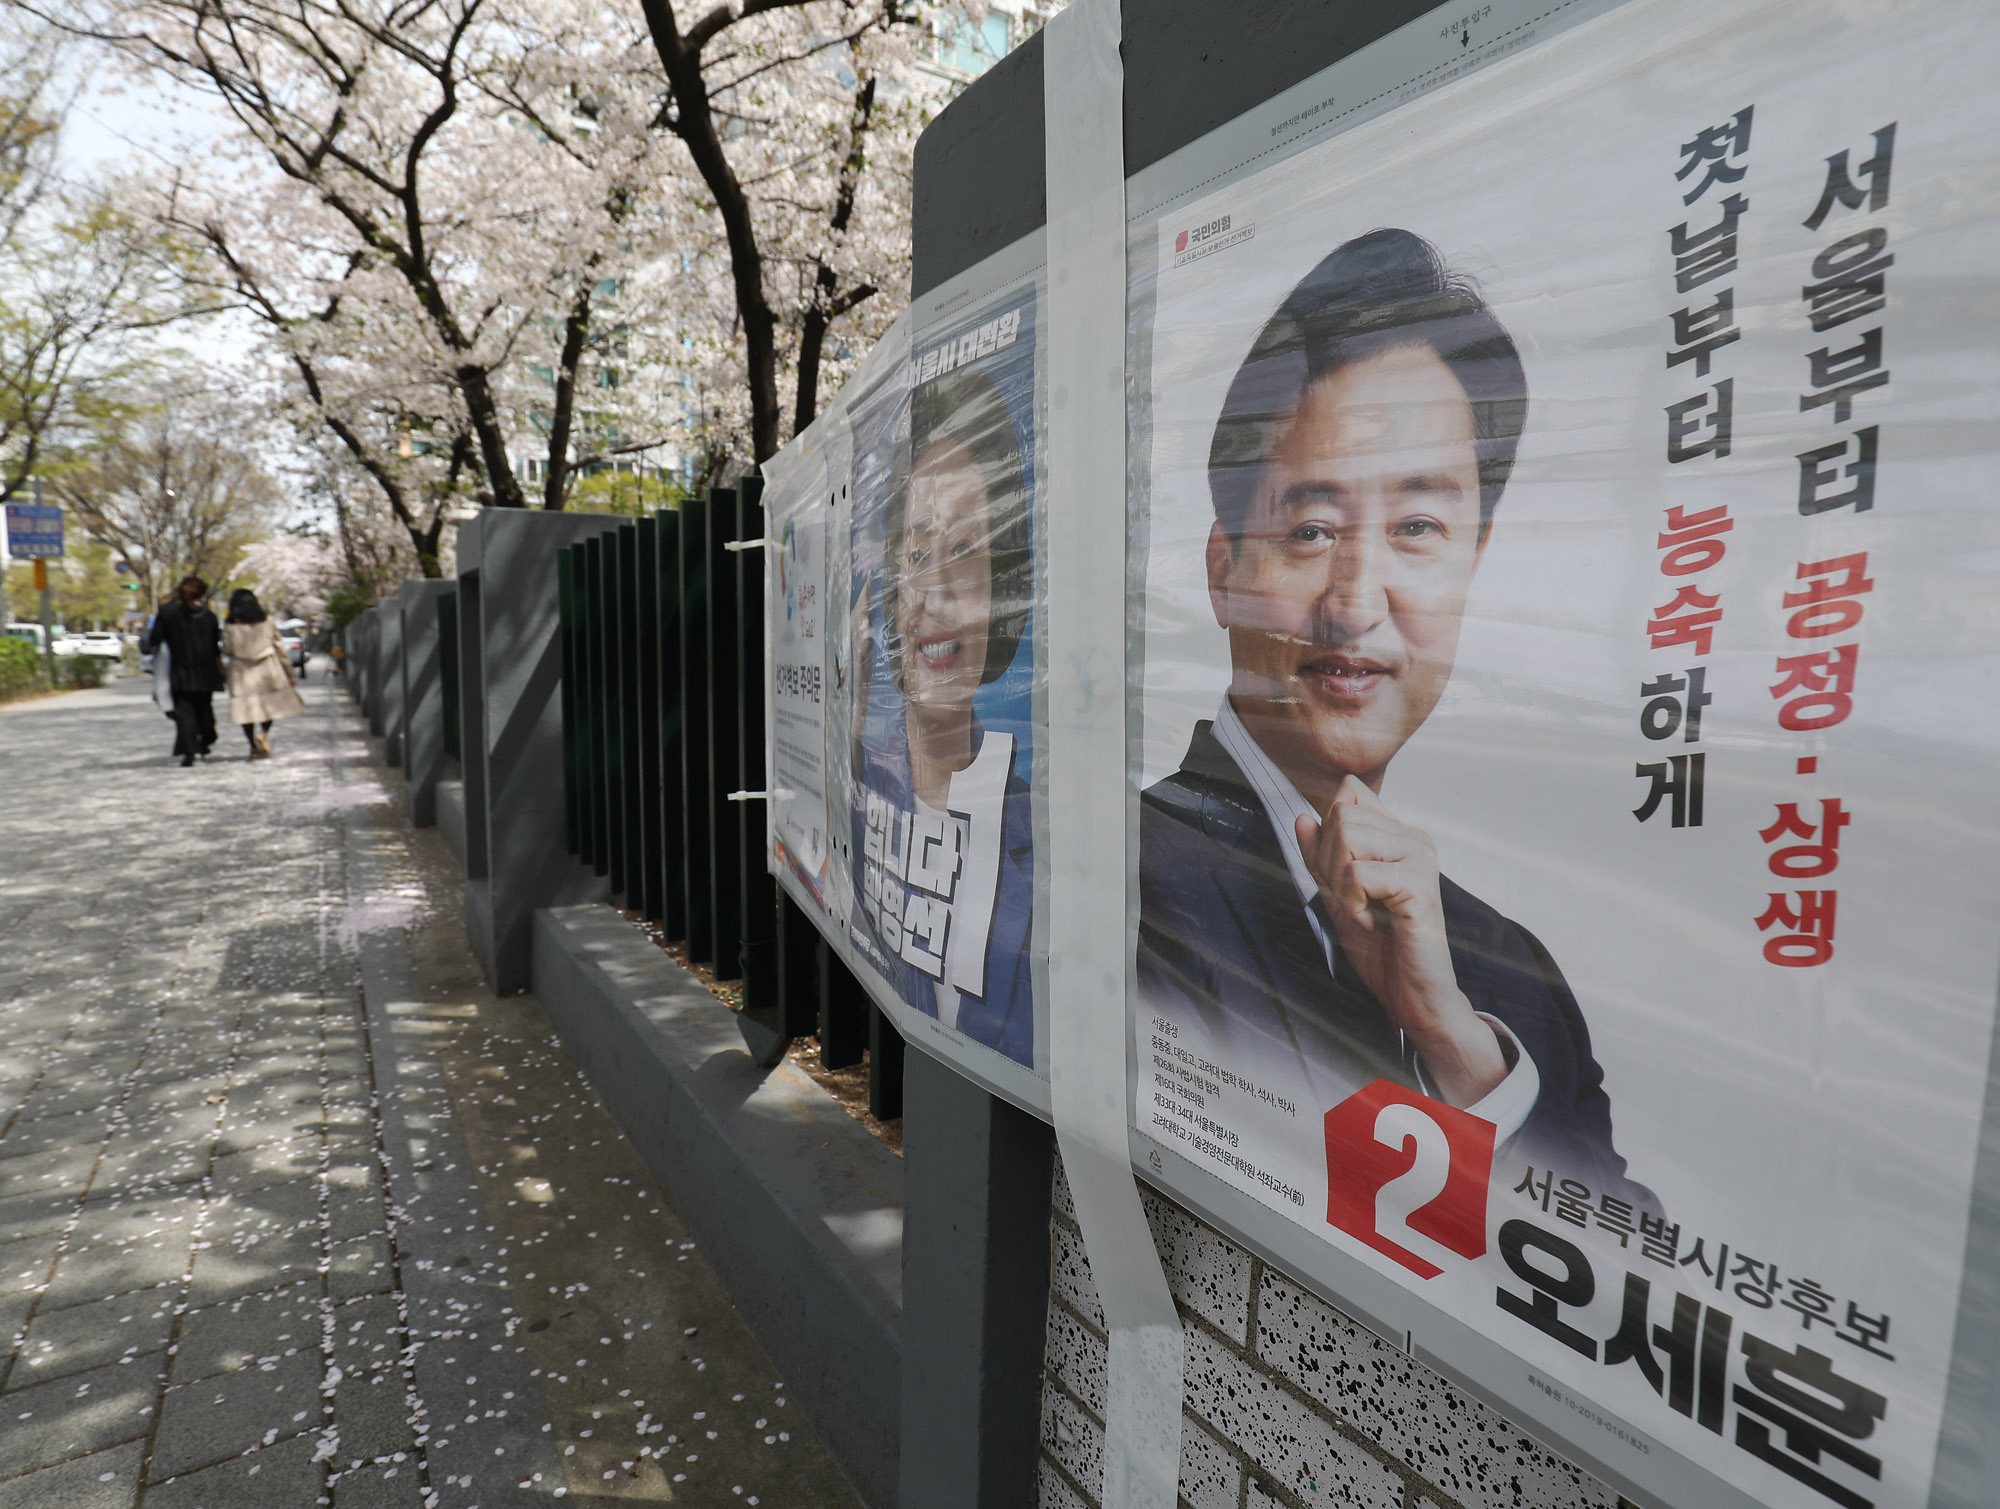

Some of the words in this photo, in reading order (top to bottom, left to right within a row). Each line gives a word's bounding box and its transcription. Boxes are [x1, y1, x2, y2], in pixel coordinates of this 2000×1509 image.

[1440, 5, 1492, 38] 사진투입구
[1301, 104, 1320, 120] 테이프
[1191, 214, 1231, 243] 국민의힘
[1663, 104, 1755, 464] 첫날부터
[957, 308, 1021, 368] 대전환
[1795, 120, 1898, 517] 서울부터
[800, 664, 821, 703] 주의문
[1632, 504, 1734, 828] 능숙하게
[863, 789, 961, 898] 합니다
[947, 731, 1014, 998] 1
[863, 859, 950, 978] 박영선
[1151, 1016, 1179, 1039] 서울출생
[1152, 1054, 1175, 1076] 제26회
[1175, 1065, 1204, 1091] 사법시험
[1204, 1080, 1221, 1099] 합격
[1154, 1072, 1176, 1095] 제16대
[1176, 1083, 1205, 1110] 국회의원
[1198, 1058, 1220, 1080] 고려대
[1220, 1068, 1237, 1089] 법학
[1238, 1077, 1257, 1098] 학사,
[1257, 1087, 1277, 1108] 석사,
[1277, 1096, 1296, 1118] 박사
[1151, 1112, 1187, 1141] 고려대학교
[1186, 1131, 1256, 1180] 기술경영전문대학원
[1256, 1169, 1305, 1207] 석좌교수(前)
[1194, 1113, 1240, 1148] 서울특별시장
[1373, 1103, 1452, 1272] 2
[1496, 1218, 1889, 1509] 오세훈
[1564, 1396, 1650, 1455] 10-2019-0161825
